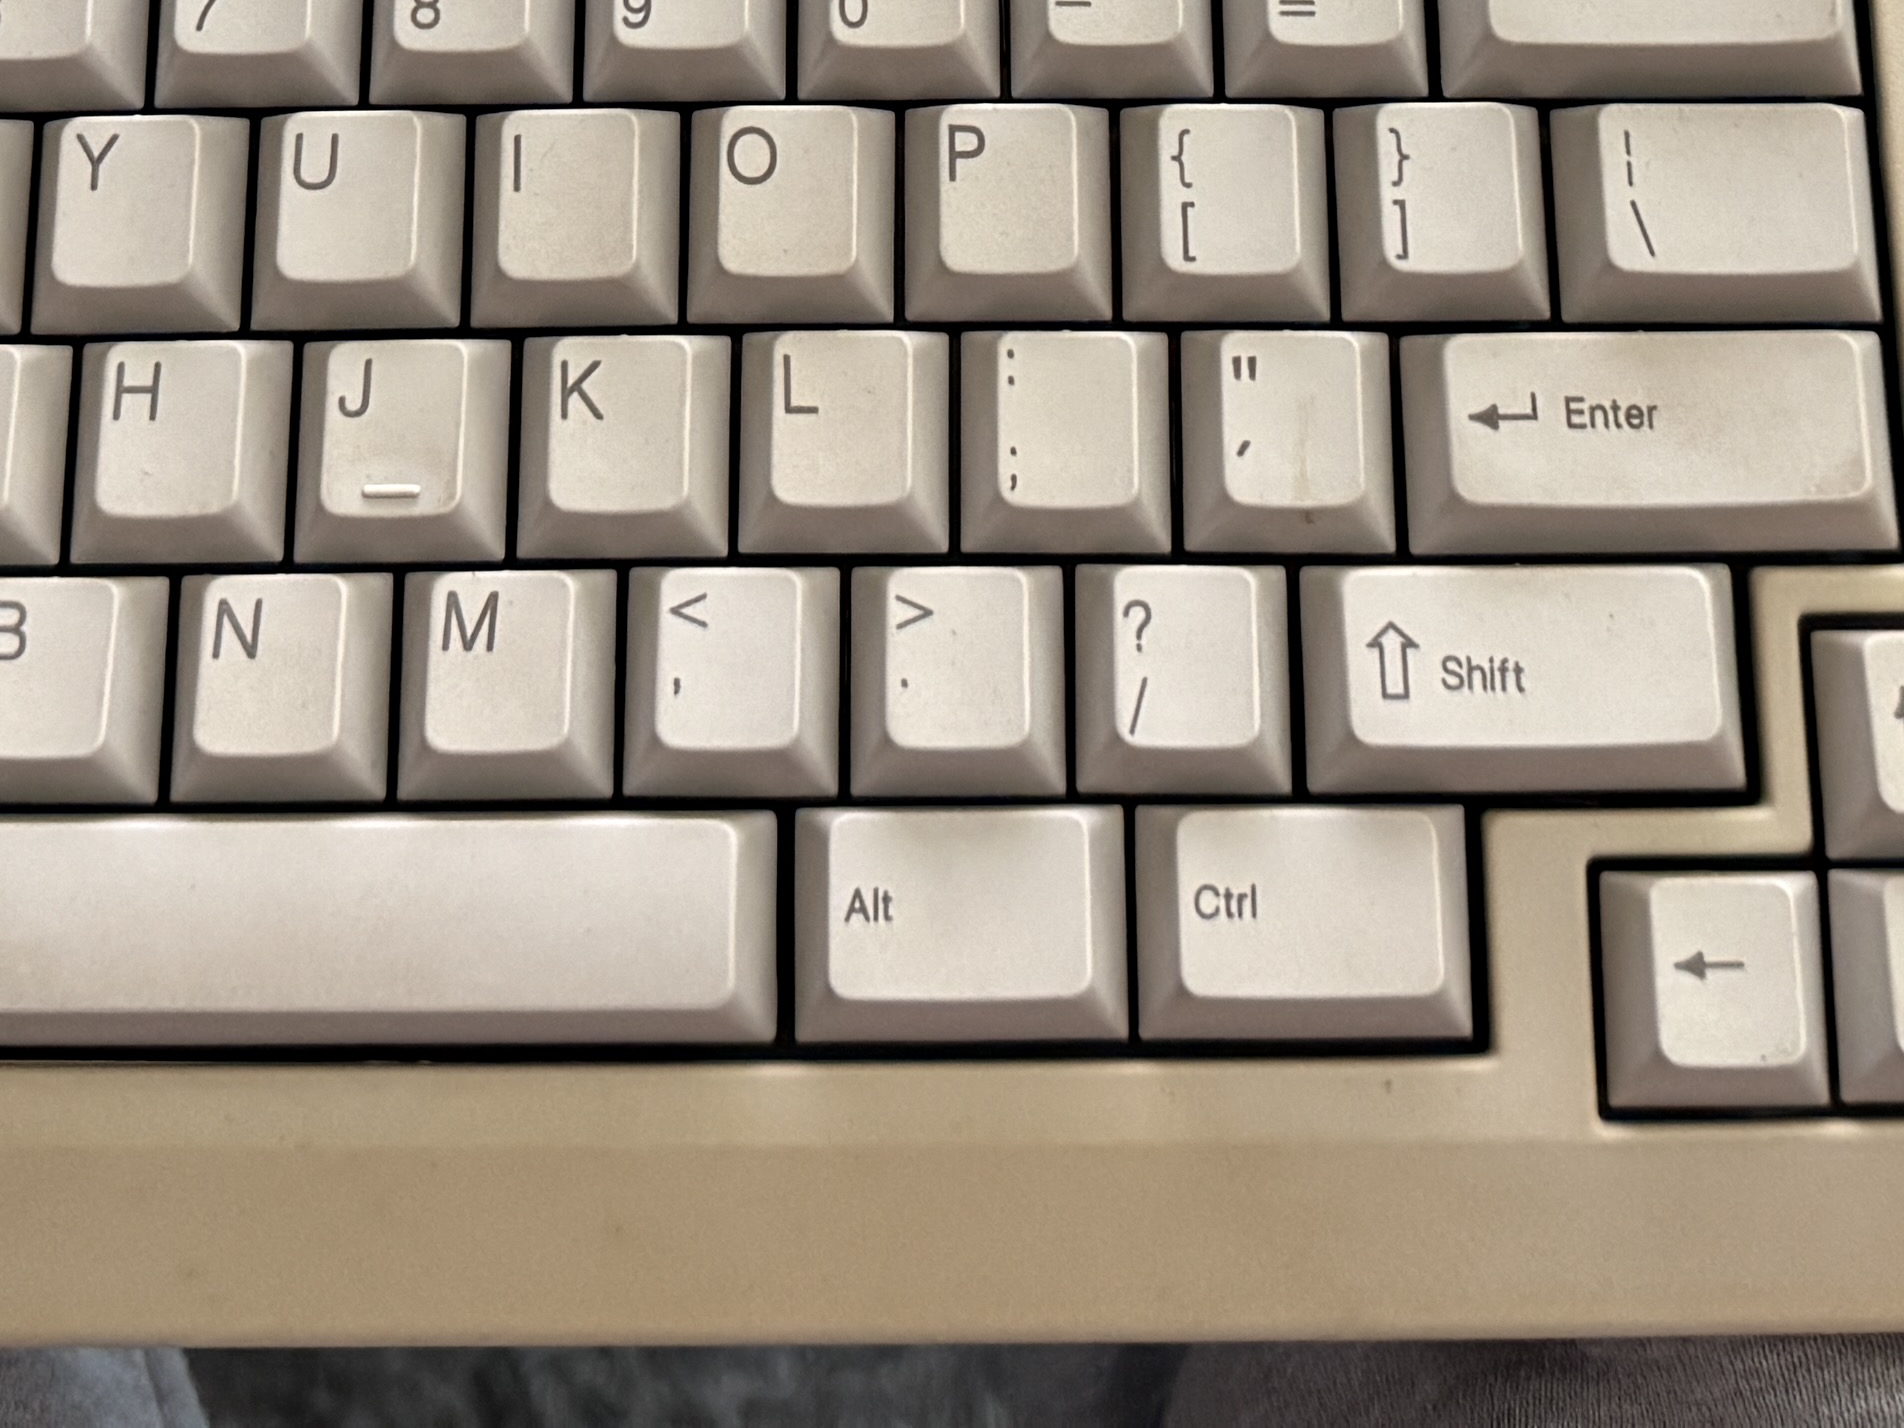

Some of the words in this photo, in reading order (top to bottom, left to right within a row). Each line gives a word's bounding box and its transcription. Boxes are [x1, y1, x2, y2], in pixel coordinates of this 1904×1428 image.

[75, 133, 120, 192] Y
[292, 132, 340, 191] U
[726, 125, 778, 186] O
[947, 123, 986, 183] P
[112, 360, 162, 422] H
[337, 357, 373, 419] J
[560, 359, 604, 421] K
[782, 353, 820, 415] L
[1564, 395, 1658, 431] Enter
[211, 597, 263, 661] N
[441, 590, 500, 653] M
[1441, 654, 1526, 694] Shift
[844, 886, 893, 924] Alt
[1193, 883, 1258, 921] Ctrl
